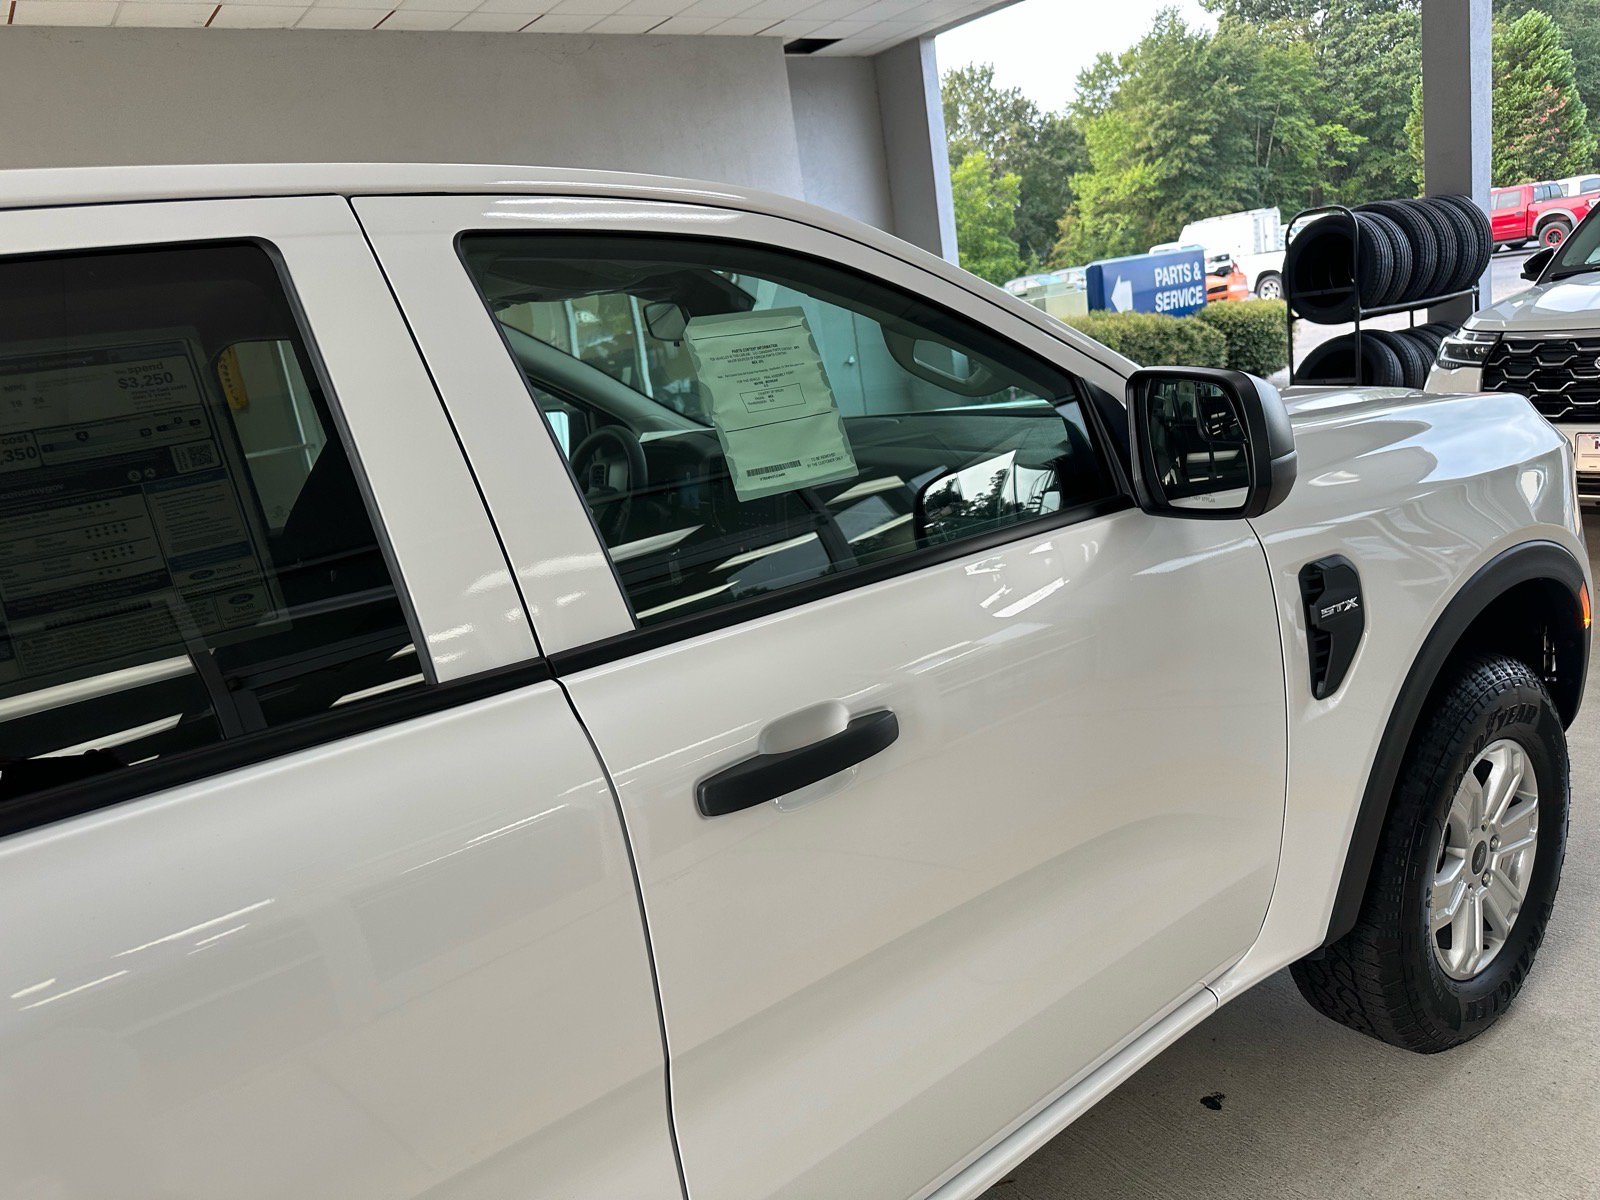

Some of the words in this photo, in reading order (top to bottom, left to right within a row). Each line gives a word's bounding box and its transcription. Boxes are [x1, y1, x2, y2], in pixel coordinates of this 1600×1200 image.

[1154, 263, 1192, 288] PARTS
[1193, 260, 1202, 280] &
[1155, 285, 1203, 313] SERVICE
[127, 361, 164, 375] spend
[118, 371, 174, 389] $3,250
[0, 446, 38, 465] ,350
[1320, 596, 1359, 619] STX
